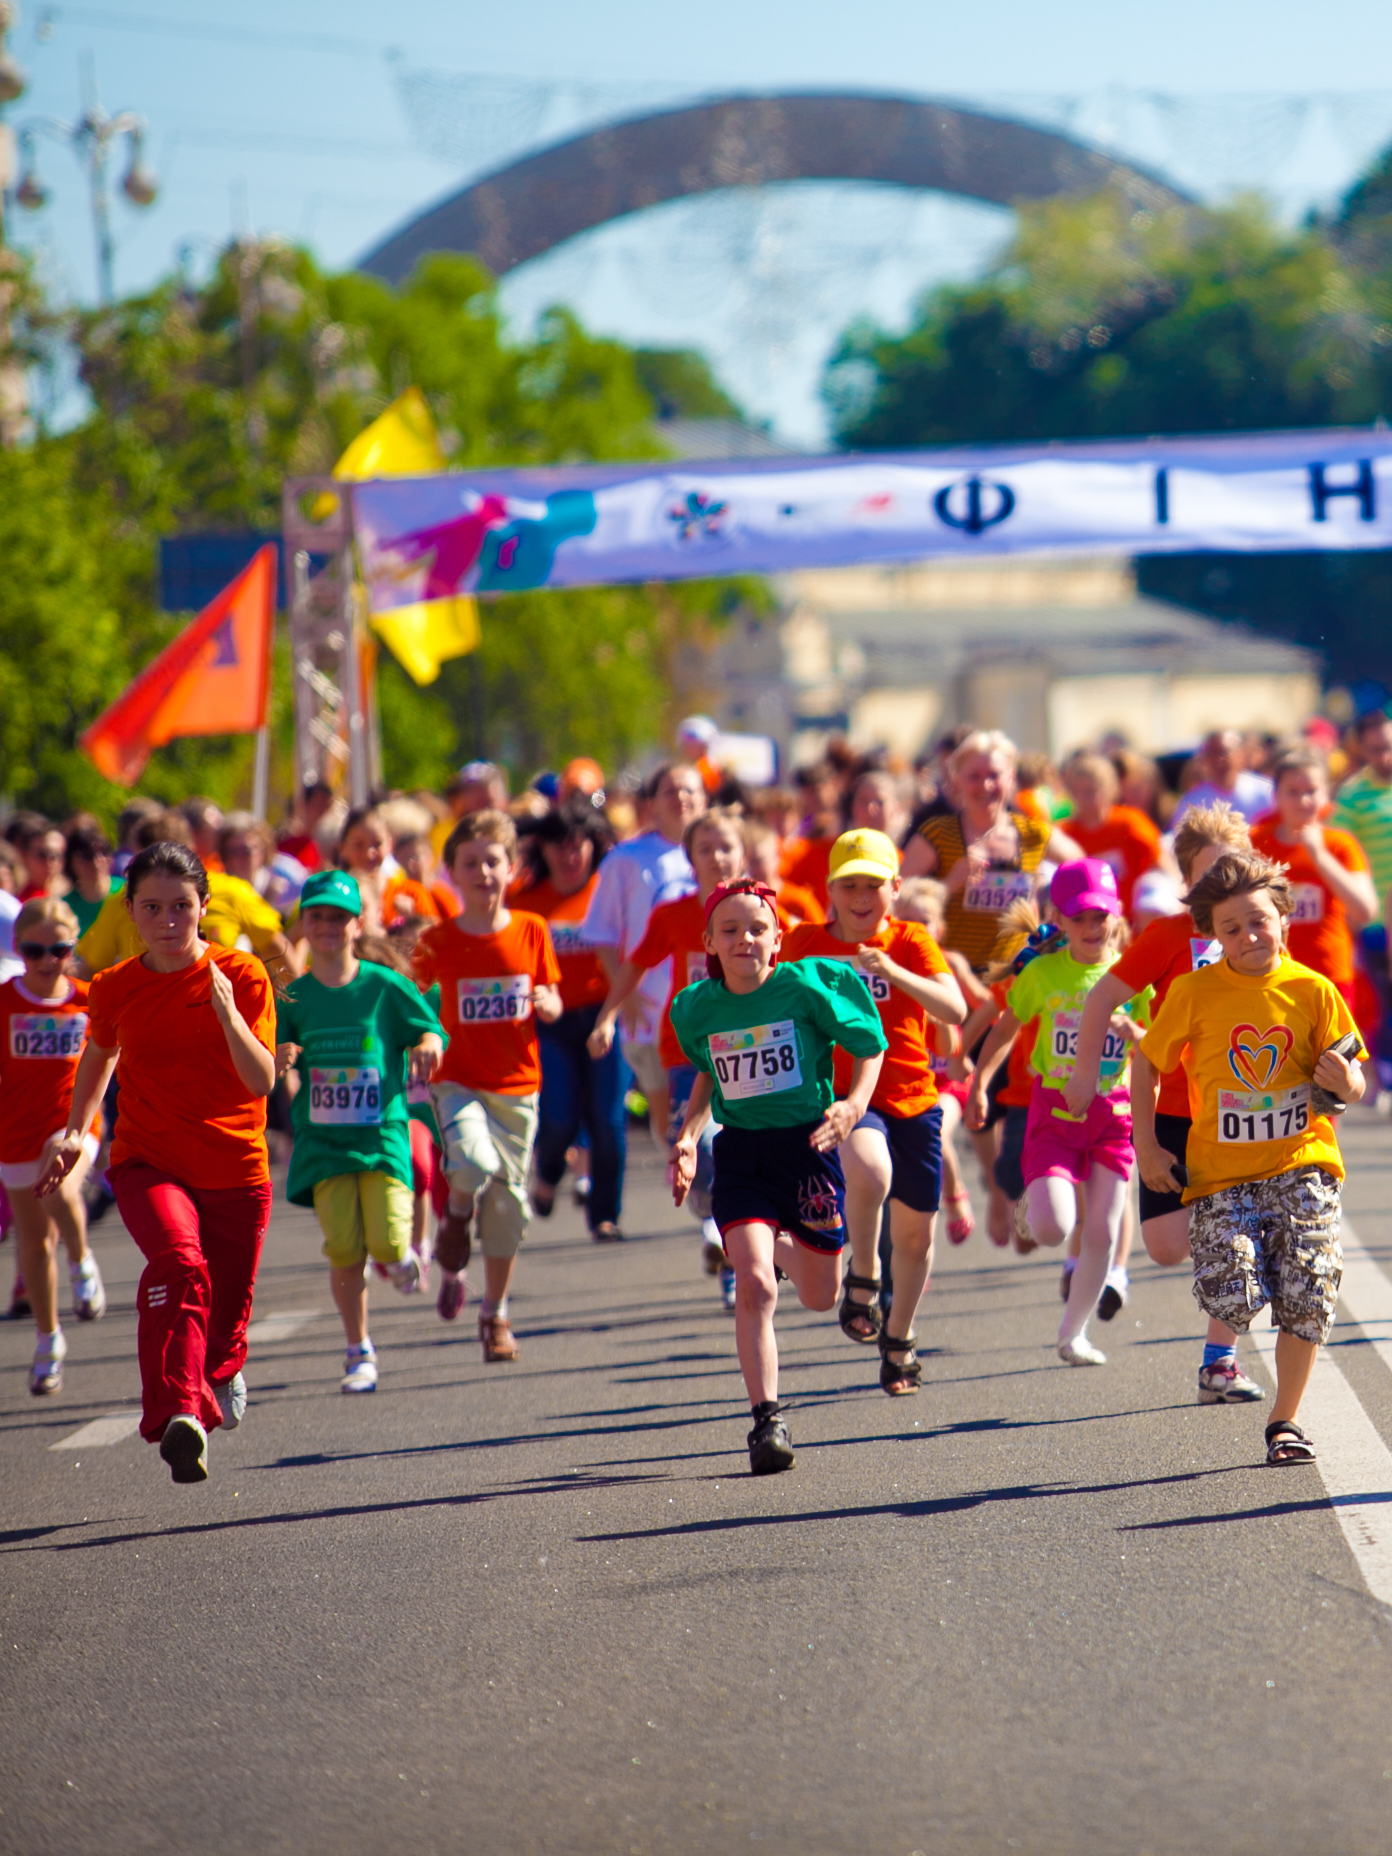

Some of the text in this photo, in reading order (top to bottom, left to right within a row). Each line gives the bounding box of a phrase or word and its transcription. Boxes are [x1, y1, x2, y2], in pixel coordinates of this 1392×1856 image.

[714, 1044, 795, 1084] 07758
[312, 1085, 379, 1109] 03976
[1223, 1102, 1308, 1140] 01175
